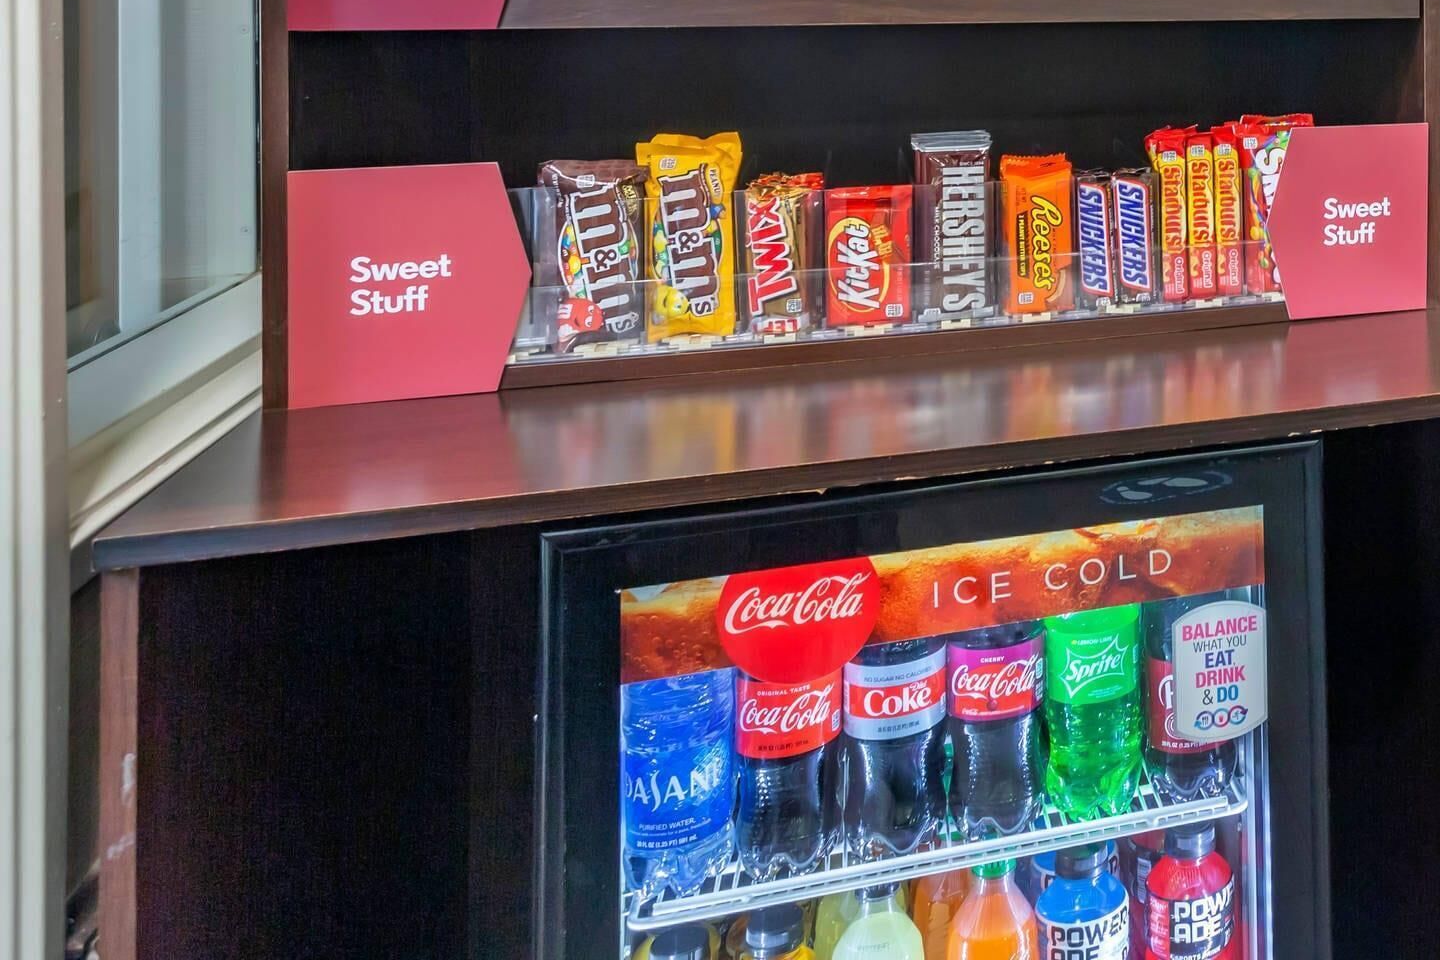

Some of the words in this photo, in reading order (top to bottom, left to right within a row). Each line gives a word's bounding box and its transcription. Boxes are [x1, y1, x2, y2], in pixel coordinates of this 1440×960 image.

[1323, 197, 1391, 219] Sweet
[942, 166, 986, 312] HERSHEY'S
[1031, 195, 1063, 290] Reese's
[1079, 186, 1108, 291] SNICKERS
[1118, 183, 1148, 287] SNICKERS
[1323, 224, 1376, 246] Stuff
[350, 253, 452, 283] Sweet
[747, 196, 797, 317] TWIX
[350, 286, 428, 316] Stuff
[933, 571, 1012, 608] ICE
[1044, 549, 1172, 590] COLD
[724, 572, 872, 635] Coca-Cola
[1181, 615, 1258, 642] BALANCE
[1193, 637, 1222, 653] WHAT
[1225, 634, 1248, 648] YOU
[980, 655, 1005, 664] CHERRY
[1065, 653, 1121, 683] Sprite
[790, 684, 810, 694] TASTE
[951, 651, 1039, 700] Coca-Cola
[1195, 665, 1247, 689] DRINK
[740, 681, 834, 735] Coca-Cola
[863, 687, 932, 717] Coke
[1202, 689, 1213, 706] &
[1216, 684, 1239, 702] DO
[1050, 906, 1128, 947] POWER
[1174, 914, 1223, 944] ADE
